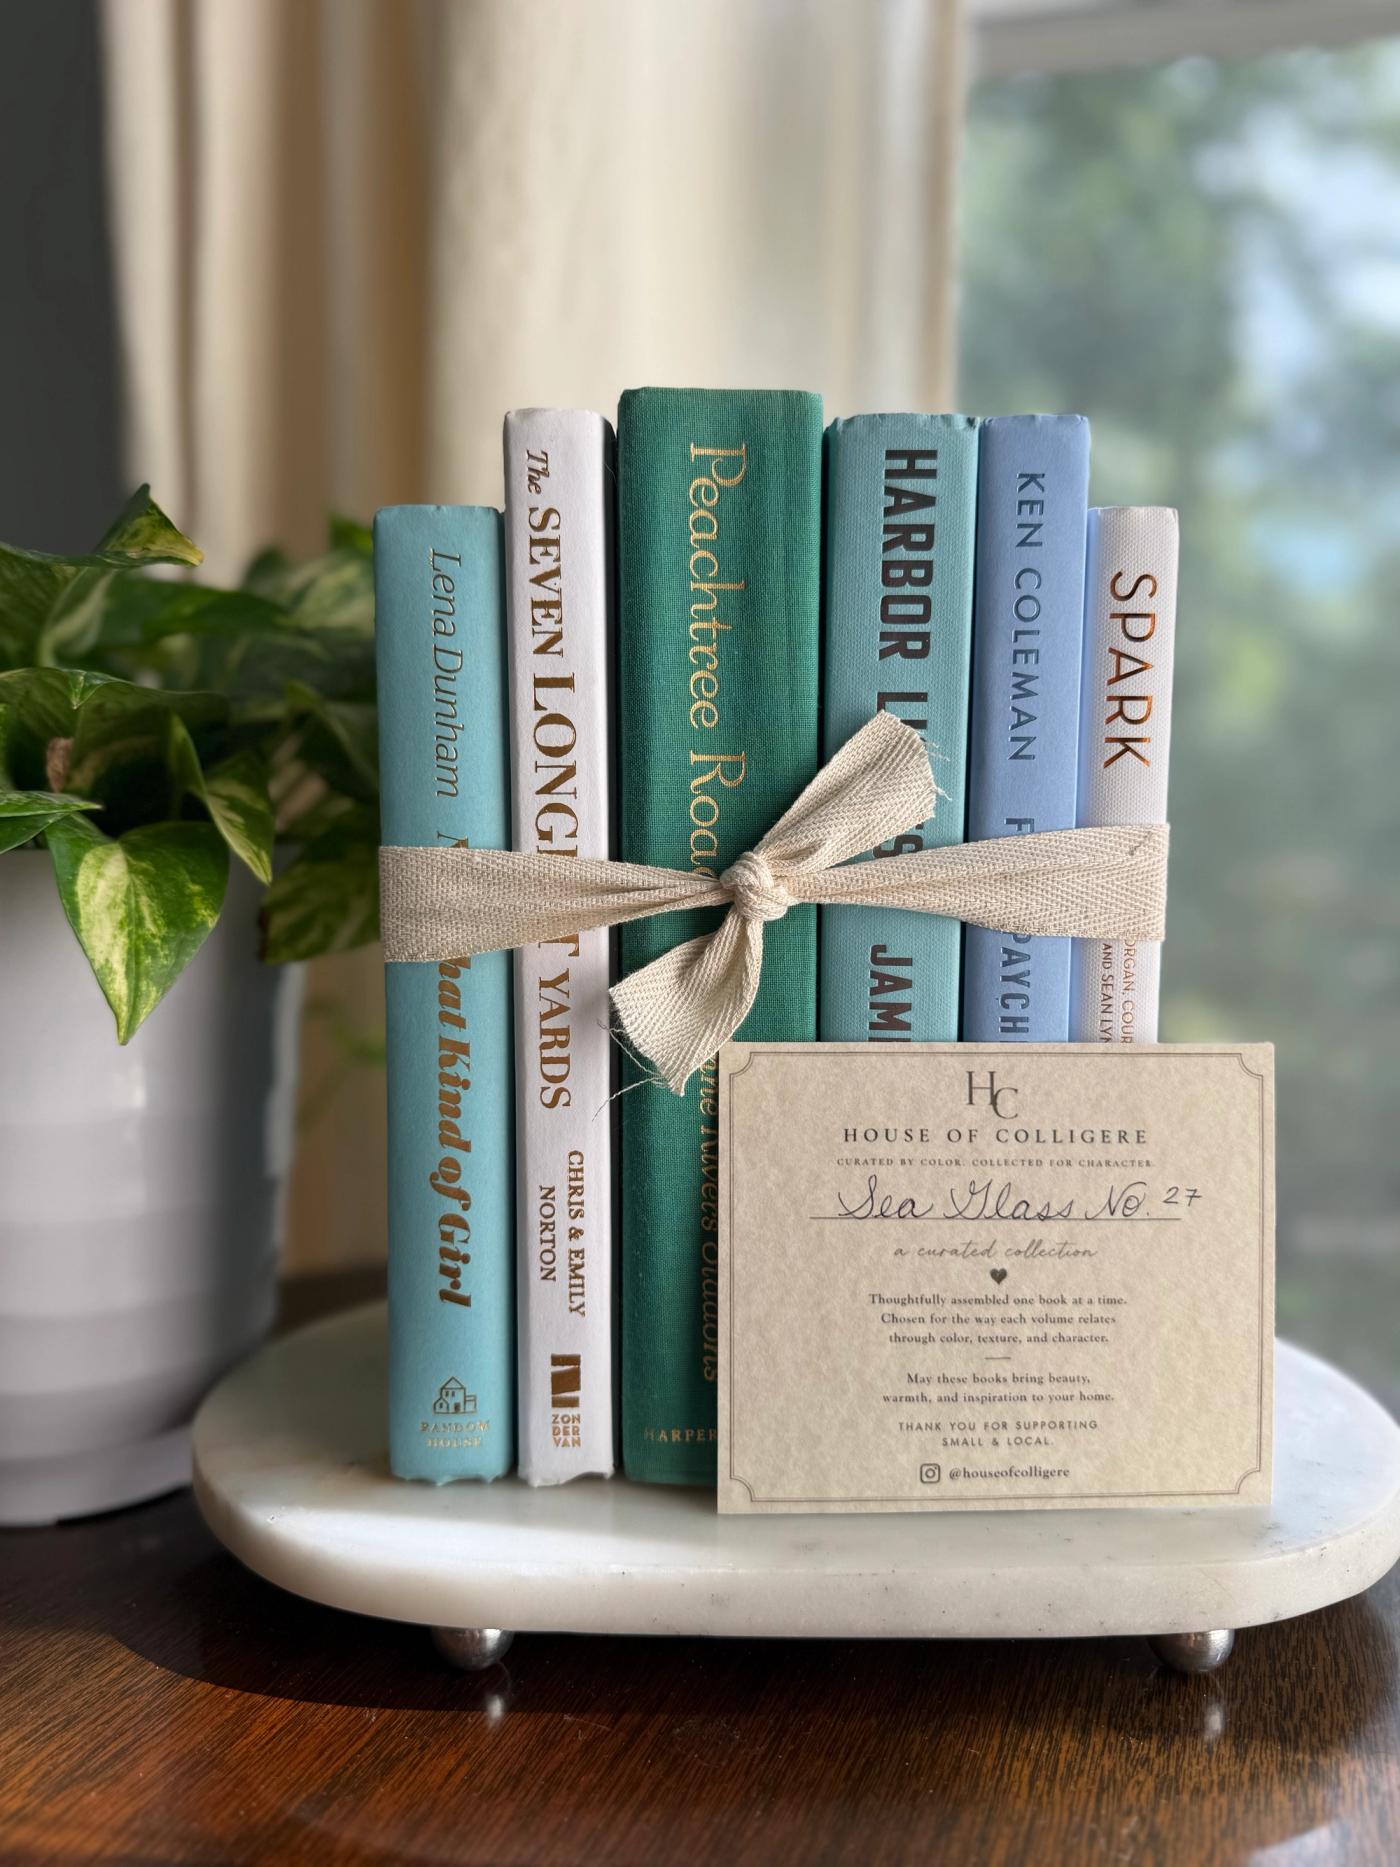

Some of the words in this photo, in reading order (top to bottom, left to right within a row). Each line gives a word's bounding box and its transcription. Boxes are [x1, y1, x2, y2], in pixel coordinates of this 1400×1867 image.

[526, 450, 550, 494] The
[1015, 472, 1046, 549] KEN
[878, 449, 938, 661] HARBOR
[430, 547, 462, 637] Lena
[528, 507, 564, 658] SEVEN
[690, 442, 748, 729] Peachtree
[1009, 572, 1043, 764] COLEMAN
[1103, 571, 1158, 769] SPARK
[434, 641, 465, 799] Dunham
[533, 673, 580, 957] LONGT
[690, 750, 747, 878] Roa
[1102, 943, 1113, 970] AND
[438, 957, 471, 1031] hat
[868, 944, 913, 1041] JAM
[998, 932, 1031, 1042] AYCH
[1100, 974, 1114, 1013] SEAN
[538, 968, 571, 1110] YARDS
[438, 1035, 471, 1152] Kind
[700, 1053, 719, 1115] nne
[966, 1071, 1019, 1119] HC
[837, 1158, 894, 1167] CURATED
[900, 1158, 914, 1167] BY
[920, 1158, 966, 1167] COLOR.
[972, 1159, 1043, 1168] COLLECTED
[1050, 1159, 1073, 1168] FOR
[843, 1128, 930, 1142] HOUSE
[947, 1129, 979, 1143] OF
[996, 1129, 1148, 1144] COLLIGERE
[430, 1156, 471, 1210] of
[568, 1150, 585, 1223] CHRIS
[838, 1174, 934, 1220] Sea
[943, 1178, 1074, 1221] Glass
[1163, 1186, 1203, 1207] 27
[539, 1185, 557, 1283] NORTON
[569, 1225, 582, 1241] &
[893, 1246, 908, 1258] a
[916, 1239, 998, 1260] curated
[1004, 1238, 1097, 1260] collection
[438, 1213, 472, 1309] Girl
[569, 1246, 586, 1318] EMILY
[868, 1293, 947, 1307] Thoughtfully
[951, 1294, 1009, 1306] assembled
[1013, 1296, 1034, 1306] one
[1038, 1294, 1068, 1306] book
[1072, 1295, 1082, 1306] at
[1087, 1297, 1093, 1305] a
[1098, 1295, 1128, 1306] time.
[881, 1312, 926, 1325] Chosen
[930, 1313, 948, 1325] for
[951, 1313, 970, 1325] the
[974, 1315, 997, 1327] way
[1000, 1313, 1027, 1325] each
[1031, 1313, 1074, 1325] volume
[1078, 1313, 1117, 1325] relates
[889, 1331, 936, 1345] through
[939, 1331, 973, 1344] color,
[977, 1333, 1023, 1345] texture,
[1026, 1331, 1049, 1344] and
[1052, 1331, 1109, 1344] character.
[882, 1391, 932, 1405] warmth,
[936, 1391, 959, 1404] and
[963, 1391, 1027, 1406] inspiration
[1031, 1393, 1044, 1403] to
[1047, 1394, 1075, 1406] your
[1079, 1391, 1114, 1403] home.
[906, 1372, 932, 1386] May
[937, 1373, 968, 1385] these
[972, 1372, 1008, 1385] books
[1012, 1372, 1044, 1386] bring
[1048, 1372, 1091, 1386] beauty,
[551, 1413, 581, 1424] ZON
[551, 1425, 581, 1436] DER
[552, 1437, 582, 1448] VAN
[899, 1421, 942, 1432] THANK
[949, 1421, 976, 1431] YOU
[983, 1421, 1008, 1431] FOR
[1015, 1420, 1098, 1431] SUPPORTING
[942, 1437, 984, 1447] SMALL
[991, 1437, 1000, 1447] &
[949, 1465, 1071, 1481] @houseofcolligere
